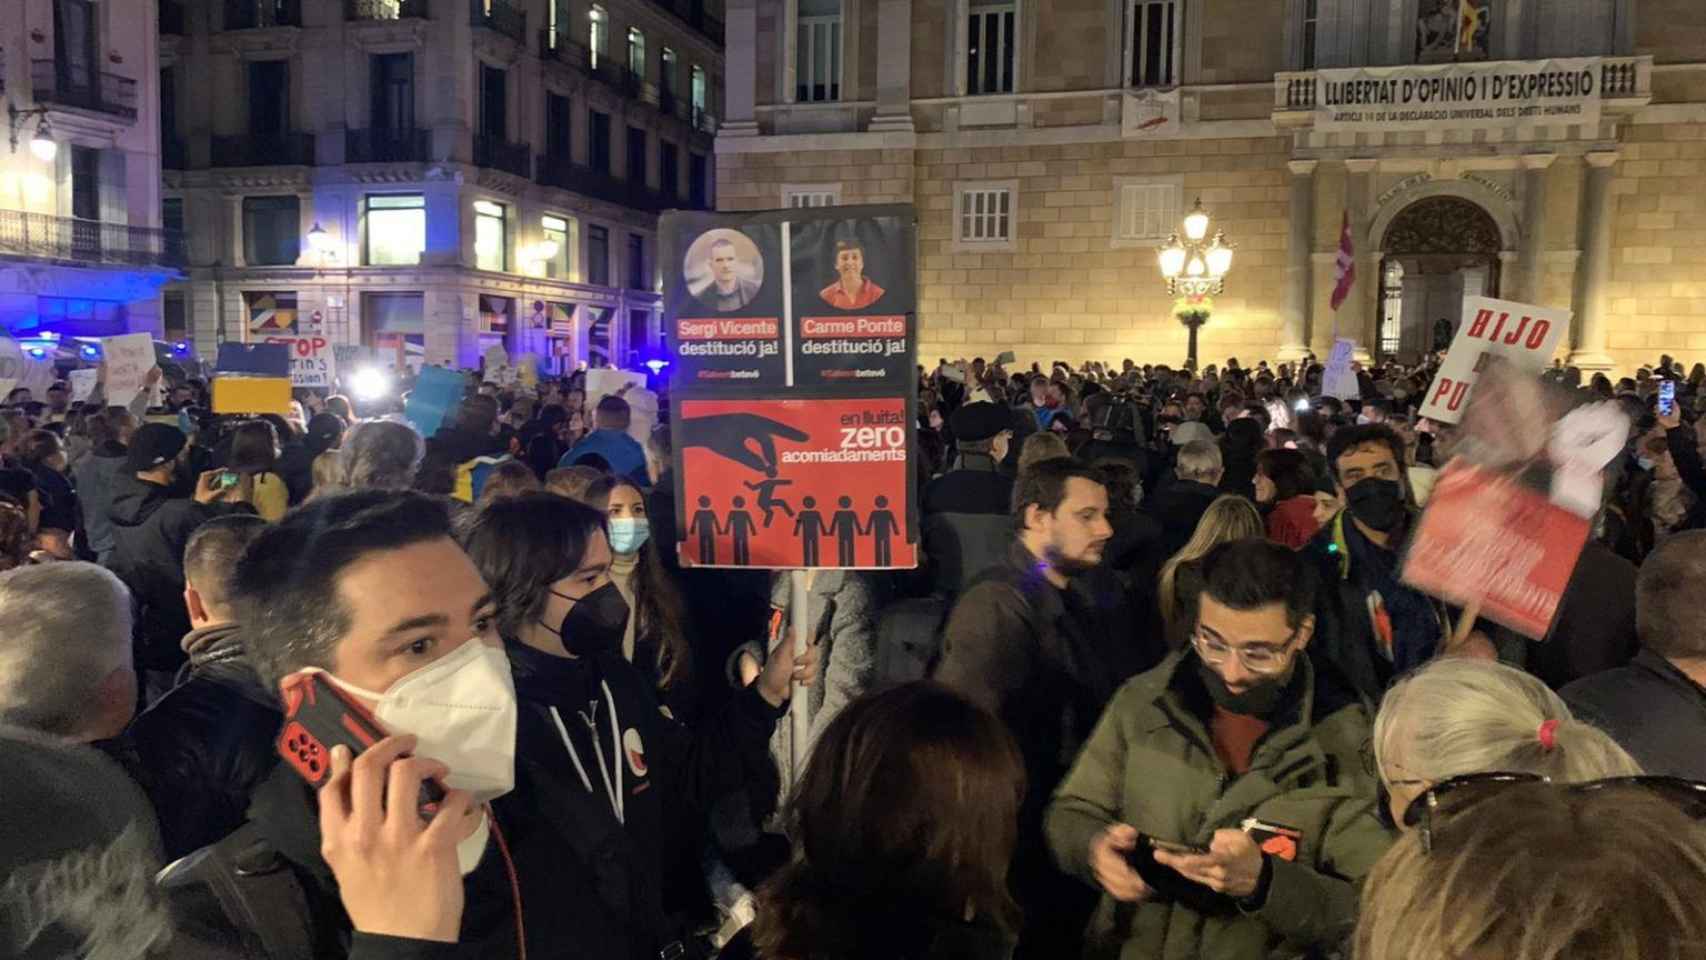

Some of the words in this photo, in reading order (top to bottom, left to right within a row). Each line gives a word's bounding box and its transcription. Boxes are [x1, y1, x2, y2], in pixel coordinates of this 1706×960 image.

[1325, 80, 1397, 105] LLIBERTAT
[1402, 71, 1477, 103] D'OPINIÓ
[1481, 76, 1487, 100] I
[1491, 65, 1593, 100] D'EXPRESSIÓ
[1388, 111, 1398, 121] LA
[680, 321, 718, 338] Sergi
[720, 320, 777, 335] Vicente
[804, 319, 855, 334] Carme
[857, 318, 903, 334] Ponte
[1467, 309, 1551, 350] HIJO
[680, 340, 756, 355] destitució
[757, 340, 778, 358] ja!
[802, 339, 883, 354] destitució
[884, 338, 906, 357] ja!
[1430, 377, 1471, 411] PU
[841, 412, 861, 425] en
[862, 408, 904, 424] lluita!
[841, 425, 905, 448] zero
[782, 446, 906, 463] acomiadaments
